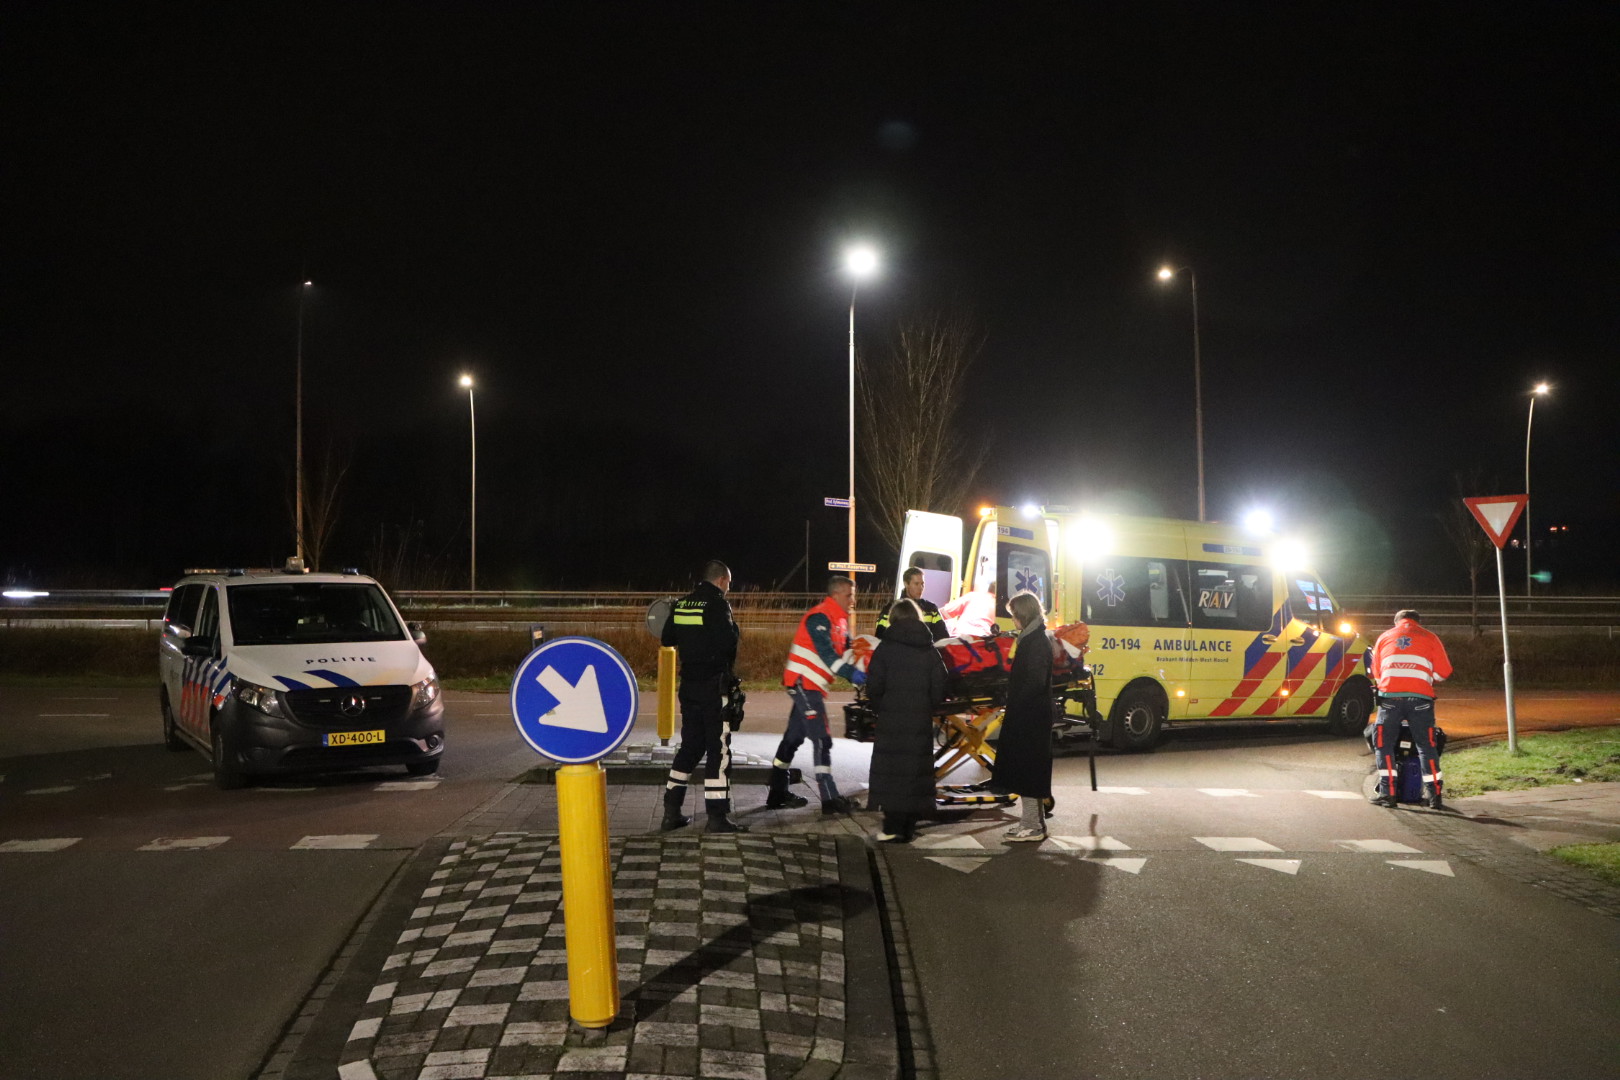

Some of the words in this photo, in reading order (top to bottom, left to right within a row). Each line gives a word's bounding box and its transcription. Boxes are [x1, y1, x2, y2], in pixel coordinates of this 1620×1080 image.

[1101, 637, 1141, 650] 20-194
[1153, 639, 1232, 652] AMBULANCE
[1088, 663, 1105, 676] 12
[331, 732, 383, 745] XD-400-L
